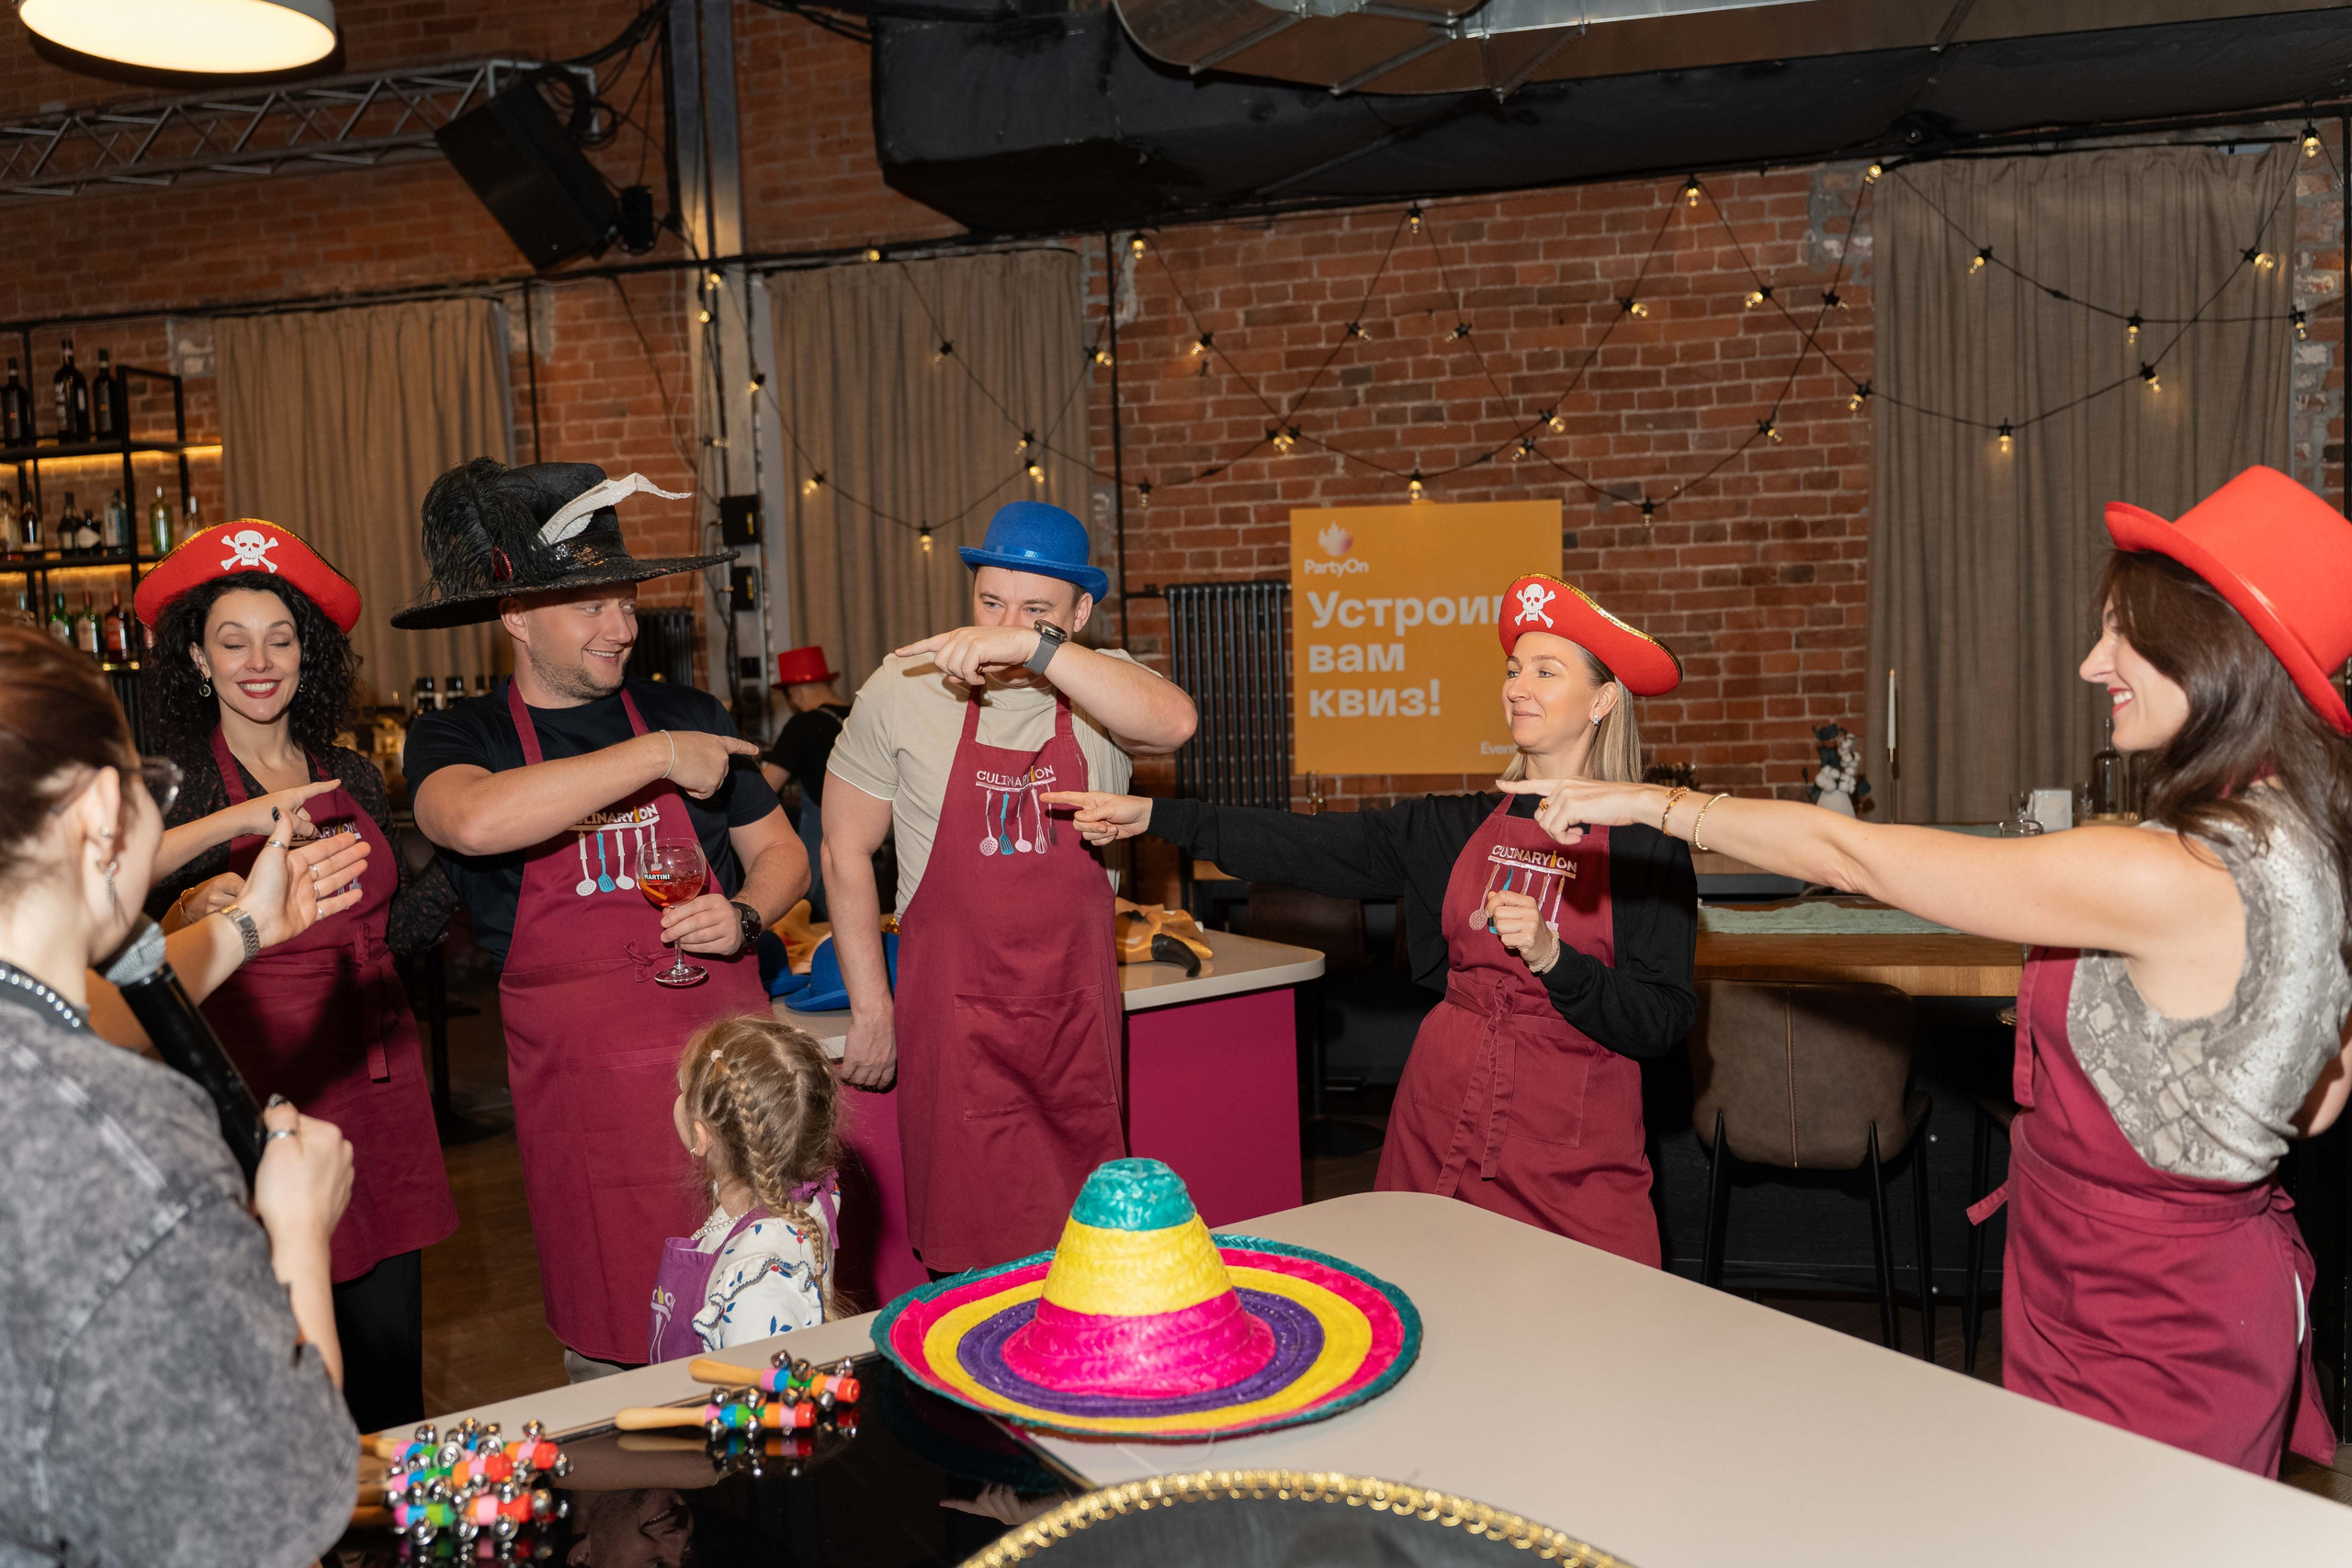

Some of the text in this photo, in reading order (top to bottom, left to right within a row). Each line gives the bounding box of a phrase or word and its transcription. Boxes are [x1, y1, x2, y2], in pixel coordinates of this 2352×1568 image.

[1305, 558, 1369, 578] PartyOn
[1308, 643, 1405, 672] вам
[1309, 679, 1441, 717] квиз!
